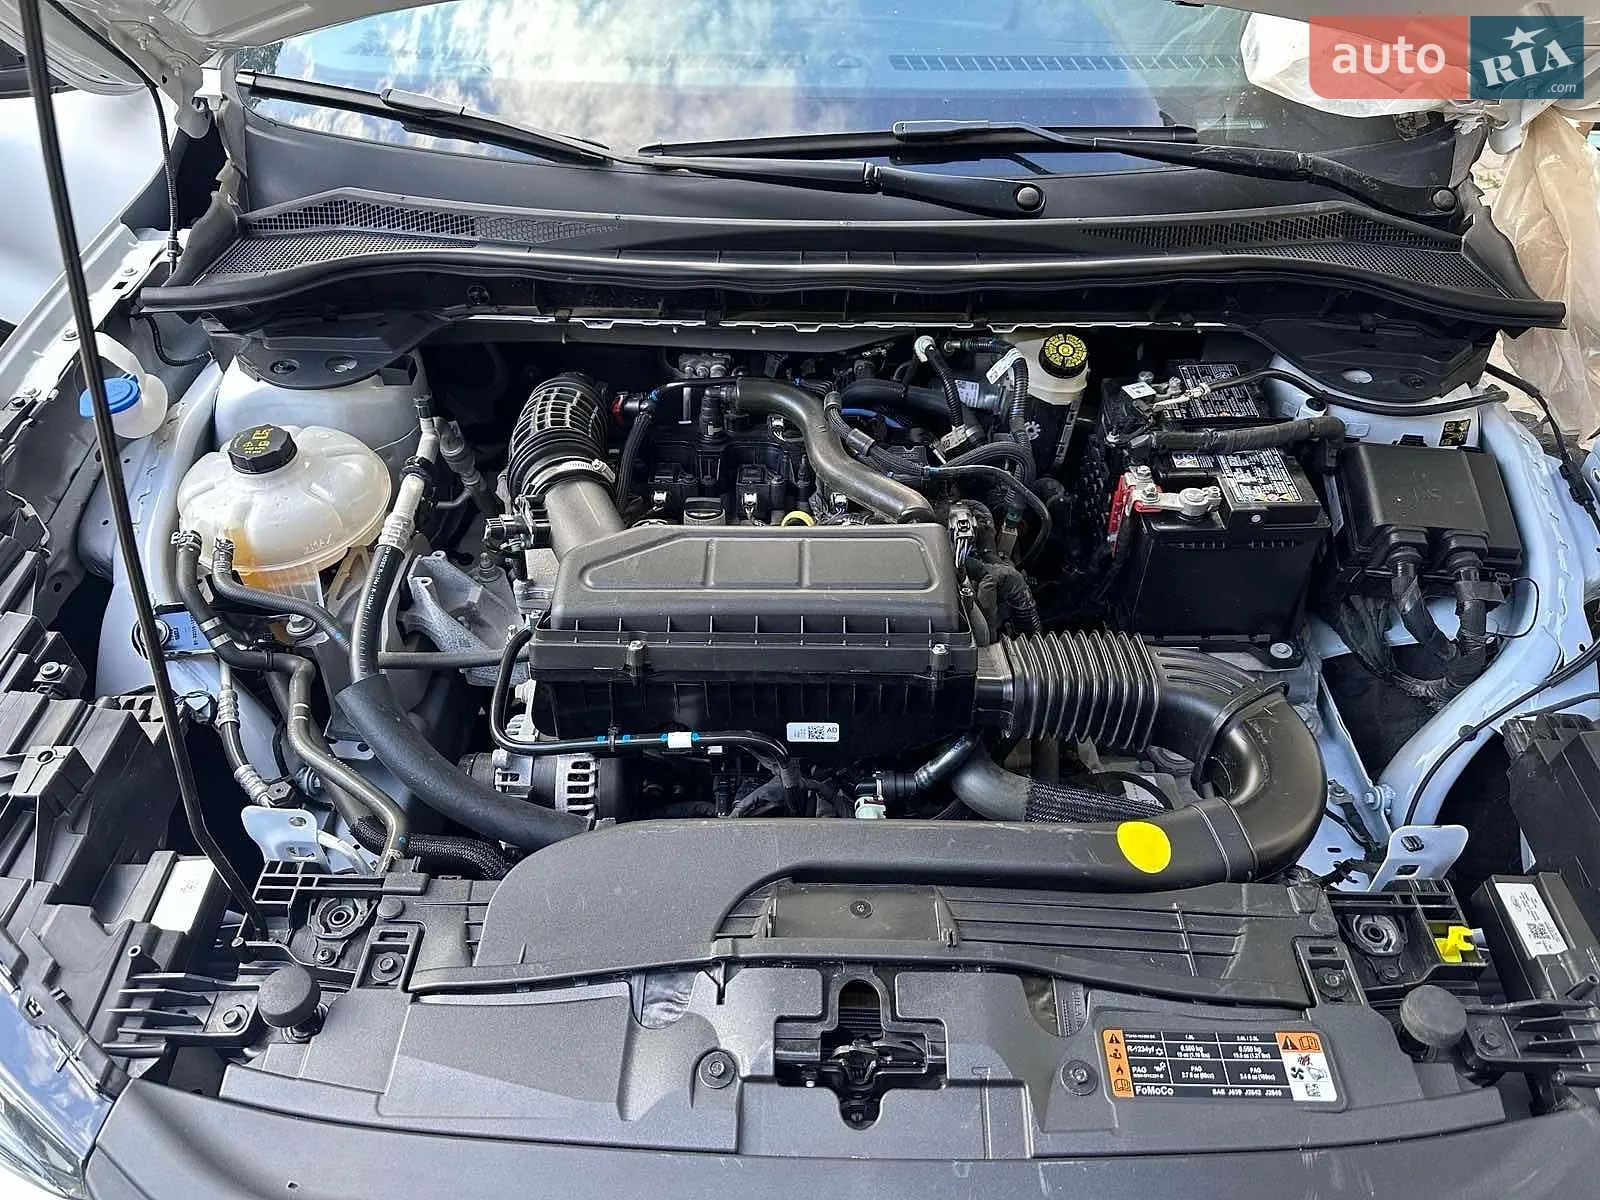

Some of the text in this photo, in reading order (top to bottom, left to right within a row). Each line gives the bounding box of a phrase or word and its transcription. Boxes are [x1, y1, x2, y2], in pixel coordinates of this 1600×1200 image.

[1127, 1045, 1155, 1053] R-1234yf
[1131, 1066, 1147, 1074] PAG
[1135, 1085, 1174, 1096] FoMoCo
